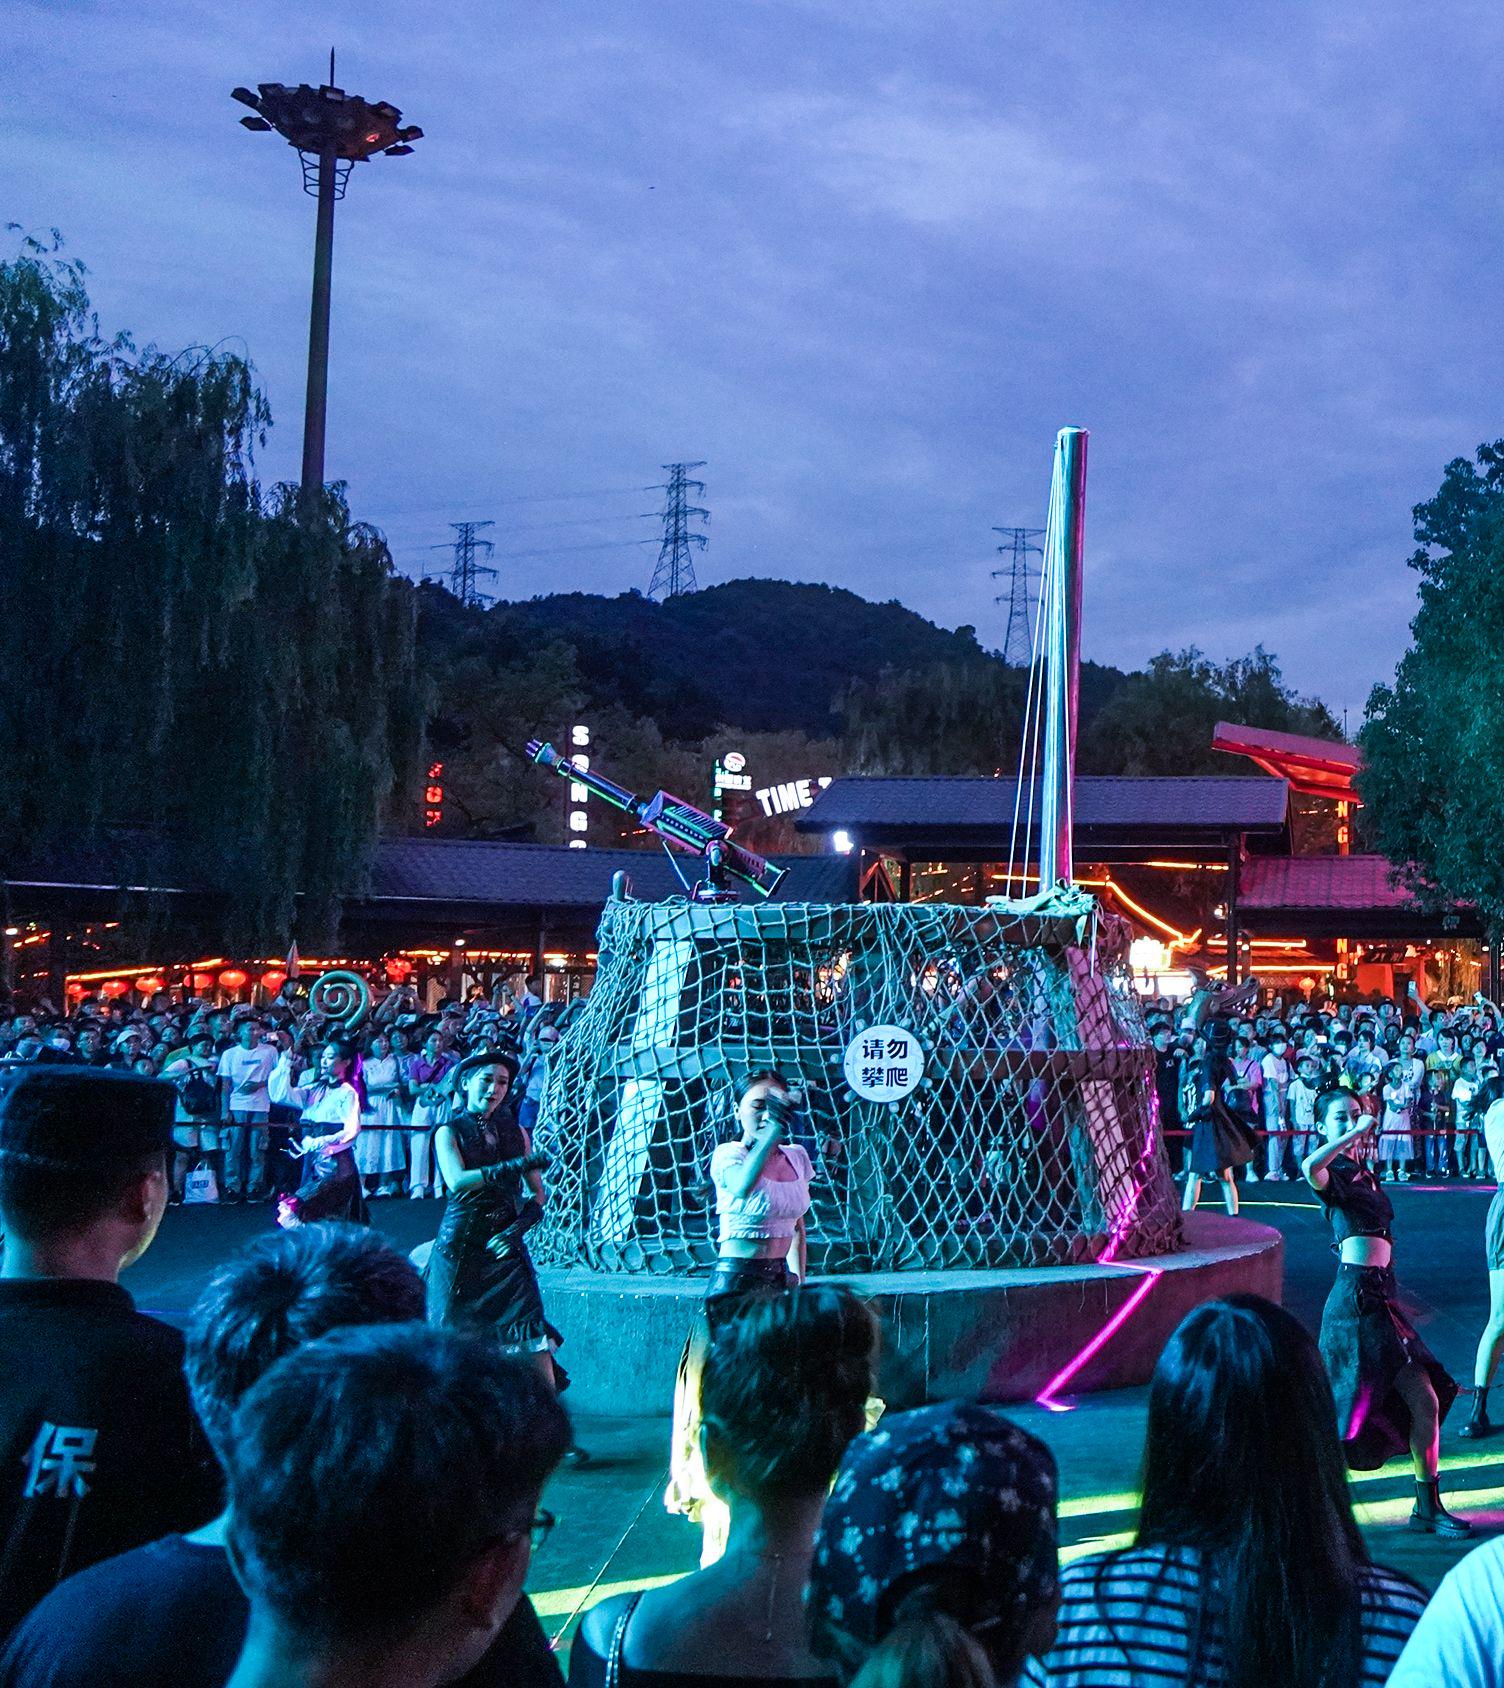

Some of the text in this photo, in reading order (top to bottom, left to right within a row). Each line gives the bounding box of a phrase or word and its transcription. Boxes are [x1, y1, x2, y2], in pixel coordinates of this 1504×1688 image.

[755, 779, 814, 817] TIME
[862, 1038, 908, 1060] 请勿
[861, 1066, 908, 1088] 攀爬
[22, 1420, 99, 1499] 保
